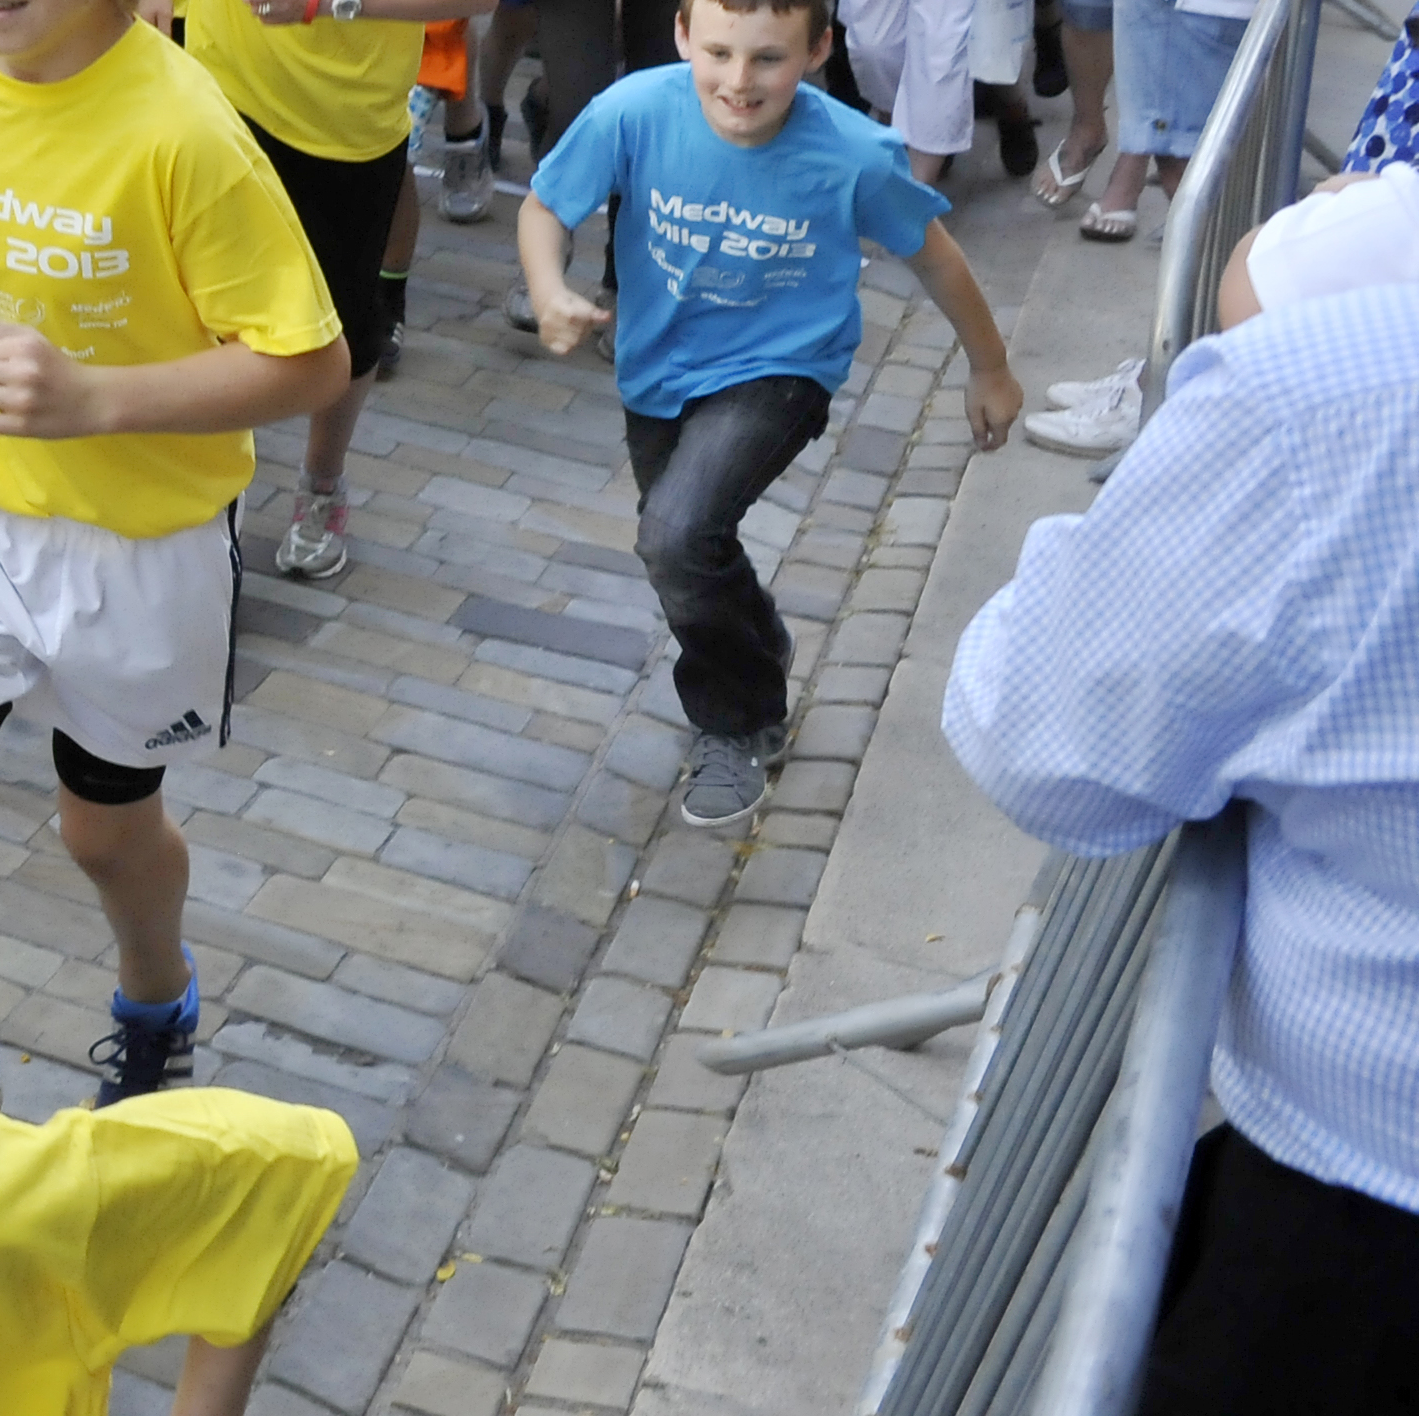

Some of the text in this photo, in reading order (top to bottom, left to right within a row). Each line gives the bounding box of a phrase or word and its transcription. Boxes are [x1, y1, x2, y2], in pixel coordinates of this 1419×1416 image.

[648, 209, 816, 260] Mile 2013
[651, 187, 810, 240] Medway
[6, 236, 130, 279] 2013
